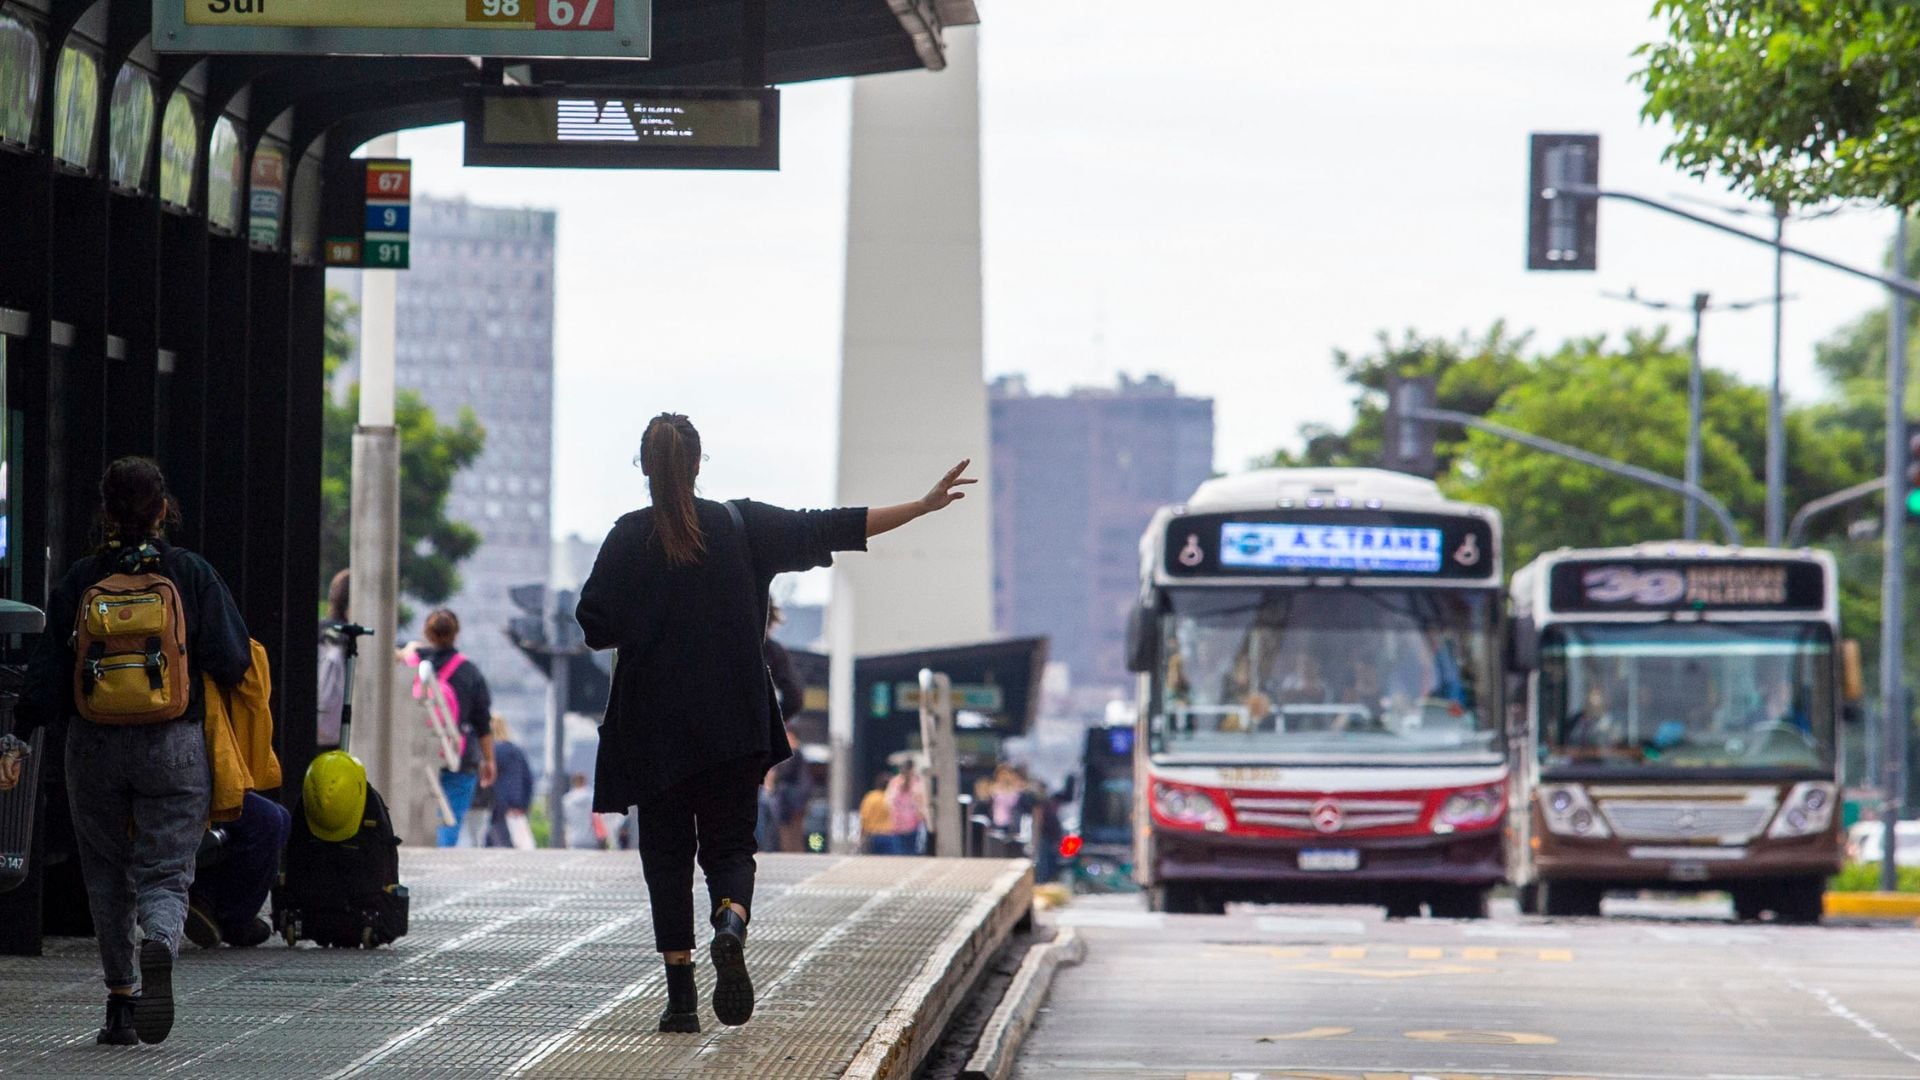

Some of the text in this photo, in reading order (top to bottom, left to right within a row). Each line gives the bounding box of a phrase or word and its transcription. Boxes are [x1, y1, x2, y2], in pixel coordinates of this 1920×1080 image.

[548, 0, 599, 26] 67
[378, 172, 403, 192] 67
[383, 207, 397, 227] 9
[378, 243, 401, 262] 91
[1583, 564, 1686, 604] 39
[8, 857, 24, 869] 147
